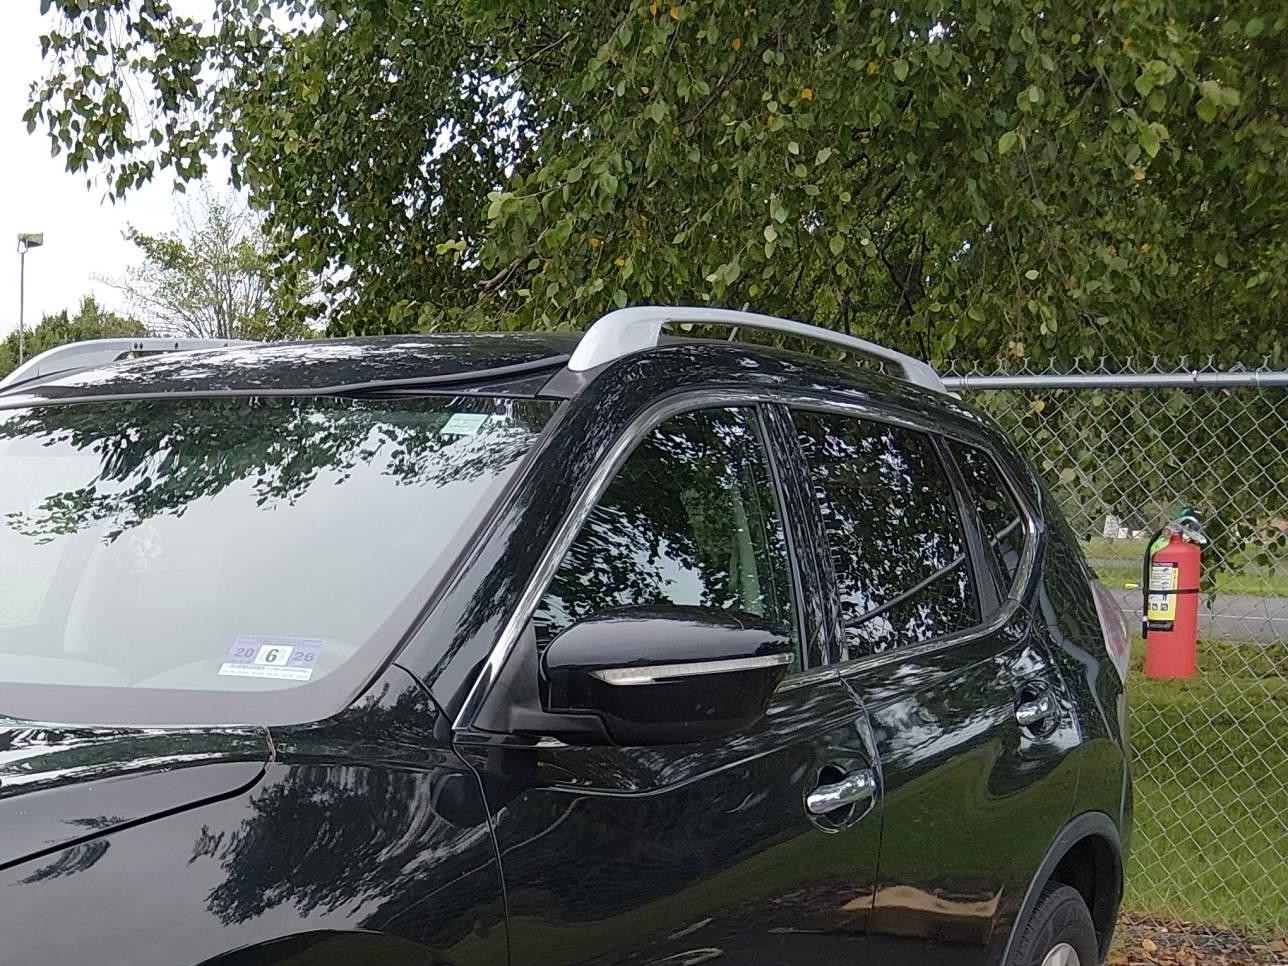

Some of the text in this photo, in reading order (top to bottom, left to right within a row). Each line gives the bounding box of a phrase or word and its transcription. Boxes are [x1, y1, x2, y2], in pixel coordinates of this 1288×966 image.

[233, 647, 315, 663] 20 6 26
